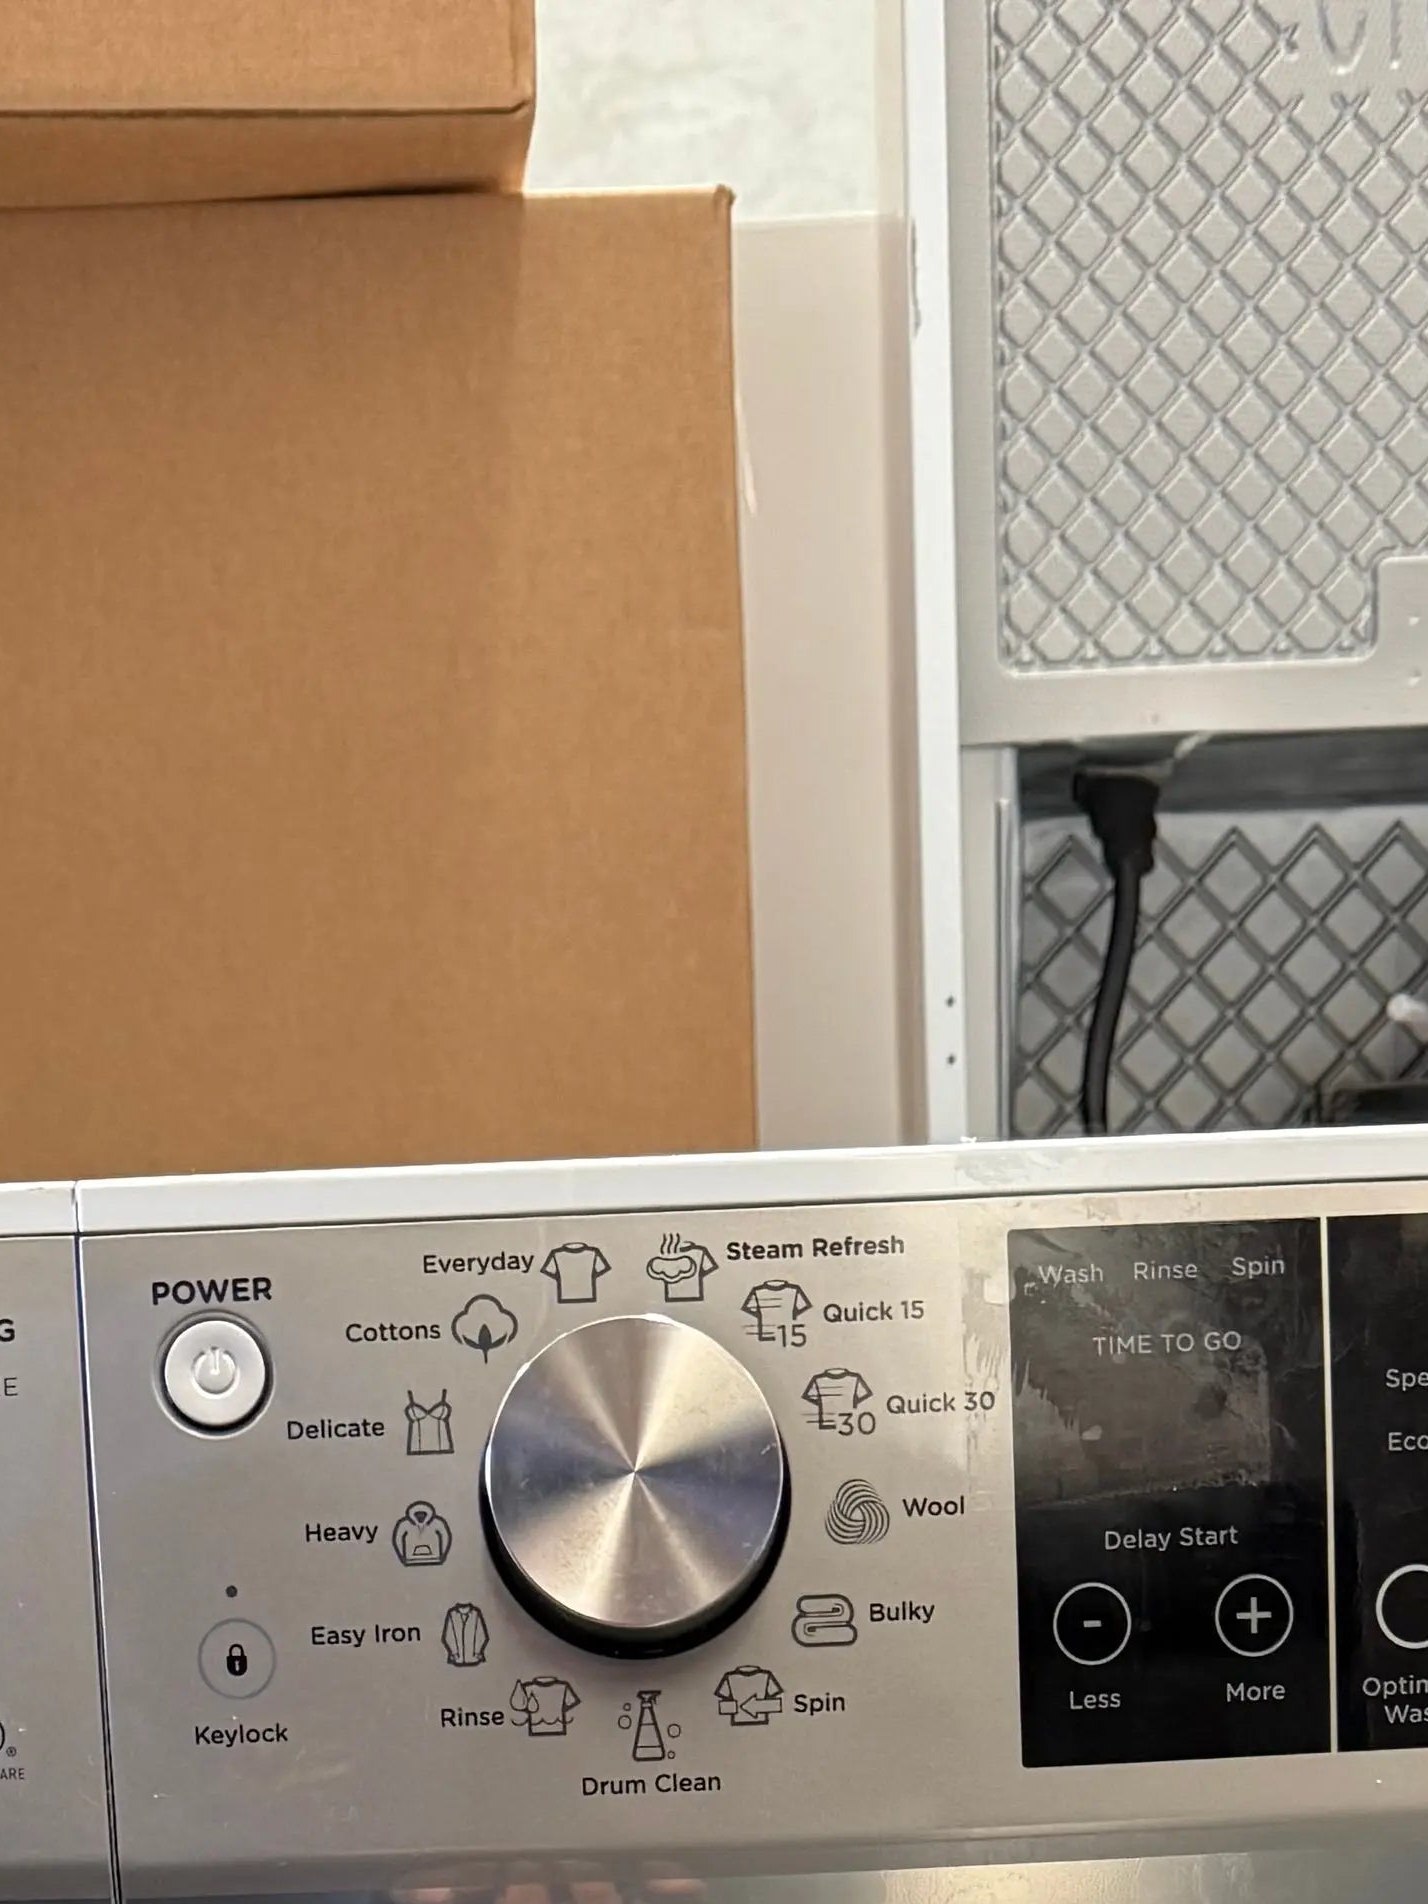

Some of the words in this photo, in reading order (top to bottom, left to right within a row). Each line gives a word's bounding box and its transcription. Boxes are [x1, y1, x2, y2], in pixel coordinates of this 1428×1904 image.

[727, 1242, 802, 1260] Steam
[813, 1236, 903, 1257] Refresh
[424, 1252, 534, 1275] Everyday
[1038, 1264, 1103, 1283] Wash
[1134, 1262, 1197, 1280] Rinse
[1232, 1257, 1284, 1279] Spin
[152, 1277, 271, 1305] POWER
[823, 1301, 892, 1322] Quick
[901, 1301, 924, 1319] 15
[346, 1324, 440, 1342] Cottons
[777, 1324, 806, 1347] 15
[1093, 1335, 1151, 1355] TIME
[1160, 1333, 1194, 1352] TO
[1204, 1331, 1241, 1351] GO
[887, 1392, 955, 1414] Quick
[964, 1391, 995, 1411] 30
[288, 1419, 384, 1439] Delicate
[838, 1412, 875, 1436] 30
[903, 1496, 964, 1516] Wool
[306, 1524, 378, 1543] Heavy
[1105, 1529, 1171, 1551] Delay
[1180, 1526, 1238, 1546] Start
[870, 1601, 934, 1623] Bulky
[312, 1627, 365, 1647] Easy
[376, 1625, 420, 1642] Iron
[1070, 1691, 1120, 1709] Less
[1227, 1683, 1285, 1702] More
[794, 1693, 845, 1716] Spin
[441, 1708, 504, 1727] Rinse
[196, 1723, 287, 1747] Keylock
[583, 1778, 645, 1795] Drum
[655, 1774, 720, 1792] Clean
